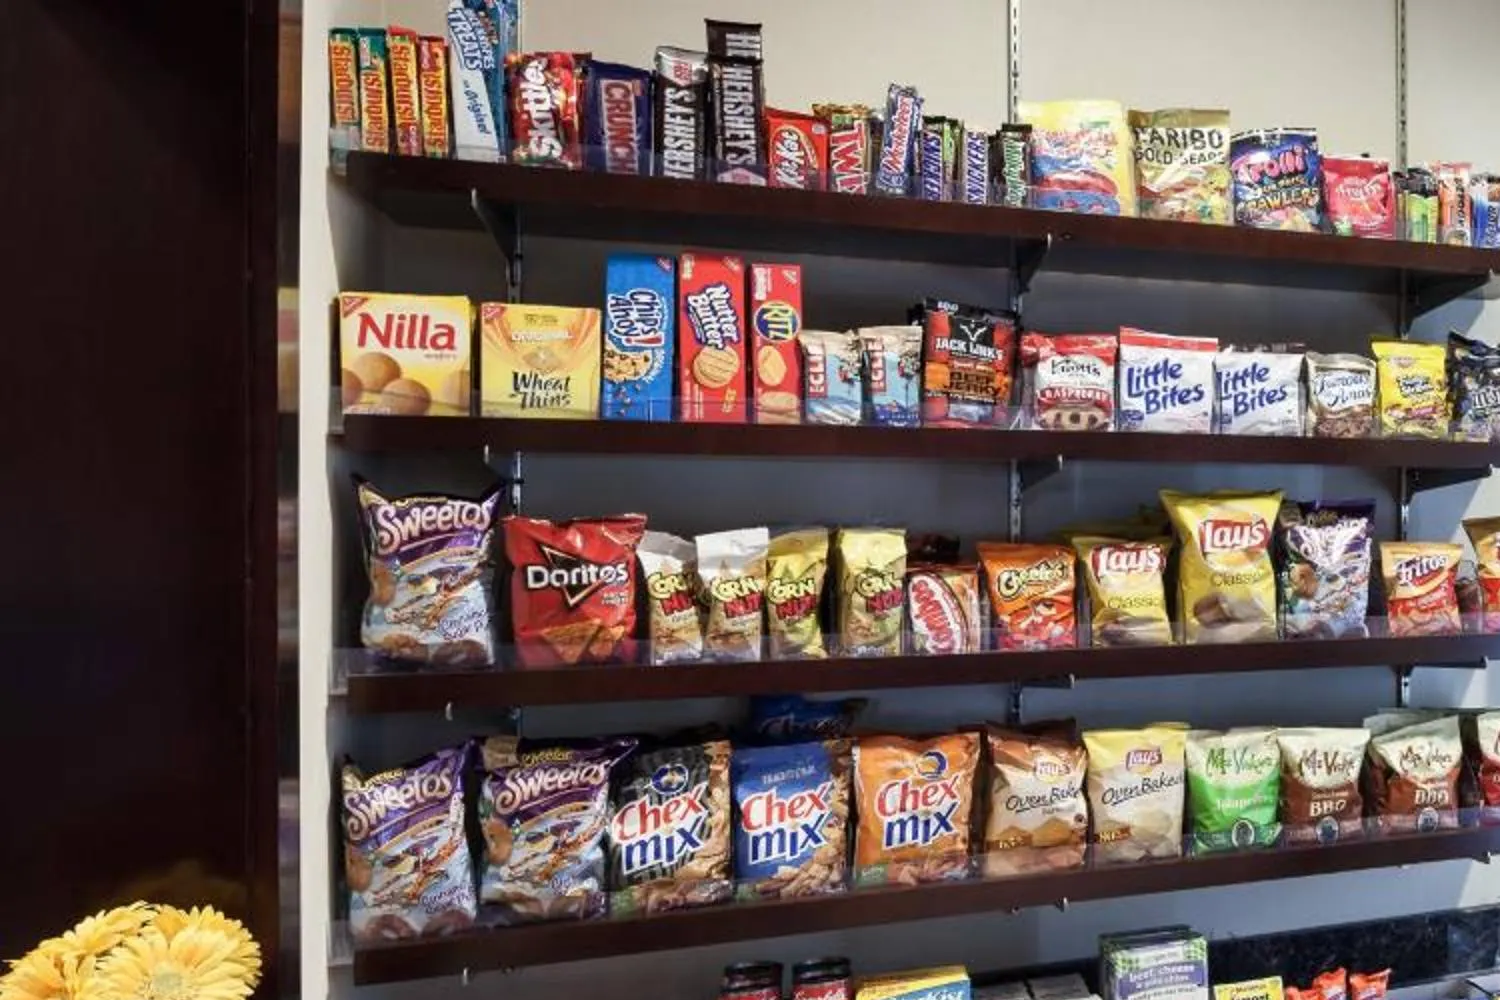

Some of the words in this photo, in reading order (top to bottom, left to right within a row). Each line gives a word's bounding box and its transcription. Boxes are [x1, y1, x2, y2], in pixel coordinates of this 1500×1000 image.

[449, 7, 483, 71] TREATS
[520, 57, 564, 159] Skittles
[604, 82, 640, 175] CRUNCH
[722, 62, 758, 167] HERSHEY'S
[358, 313, 458, 351] Nilla
[629, 290, 659, 337] Chips
[688, 294, 726, 350] Butter
[706, 284, 739, 343] Nutter
[763, 302, 793, 340] RITZ
[935, 337, 968, 350] JACK
[511, 370, 572, 394] Wheat
[1126, 357, 1183, 399] Little
[1144, 383, 1205, 415] Bites
[1216, 361, 1270, 401] Little
[509, 390, 572, 411] Thins
[1232, 384, 1289, 418] Bites
[375, 499, 493, 553] Sweetos
[1200, 518, 1267, 553] Lay's
[526, 562, 630, 589] Doritos
[1097, 545, 1162, 576] Lay's
[1392, 553, 1447, 588] Fritos
[767, 577, 816, 604] CORN
[1127, 750, 1162, 767] Lay's
[344, 766, 453, 841] Sweetos
[495, 759, 611, 816] Sweetos
[740, 783, 834, 833] Chex
[876, 774, 961, 819] Chex
[1005, 795, 1049, 812] Oven
[1101, 786, 1140, 805] Oven
[613, 783, 709, 842] Chex
[884, 801, 961, 849] mix
[624, 811, 708, 875] mix
[750, 813, 830, 865] mix
